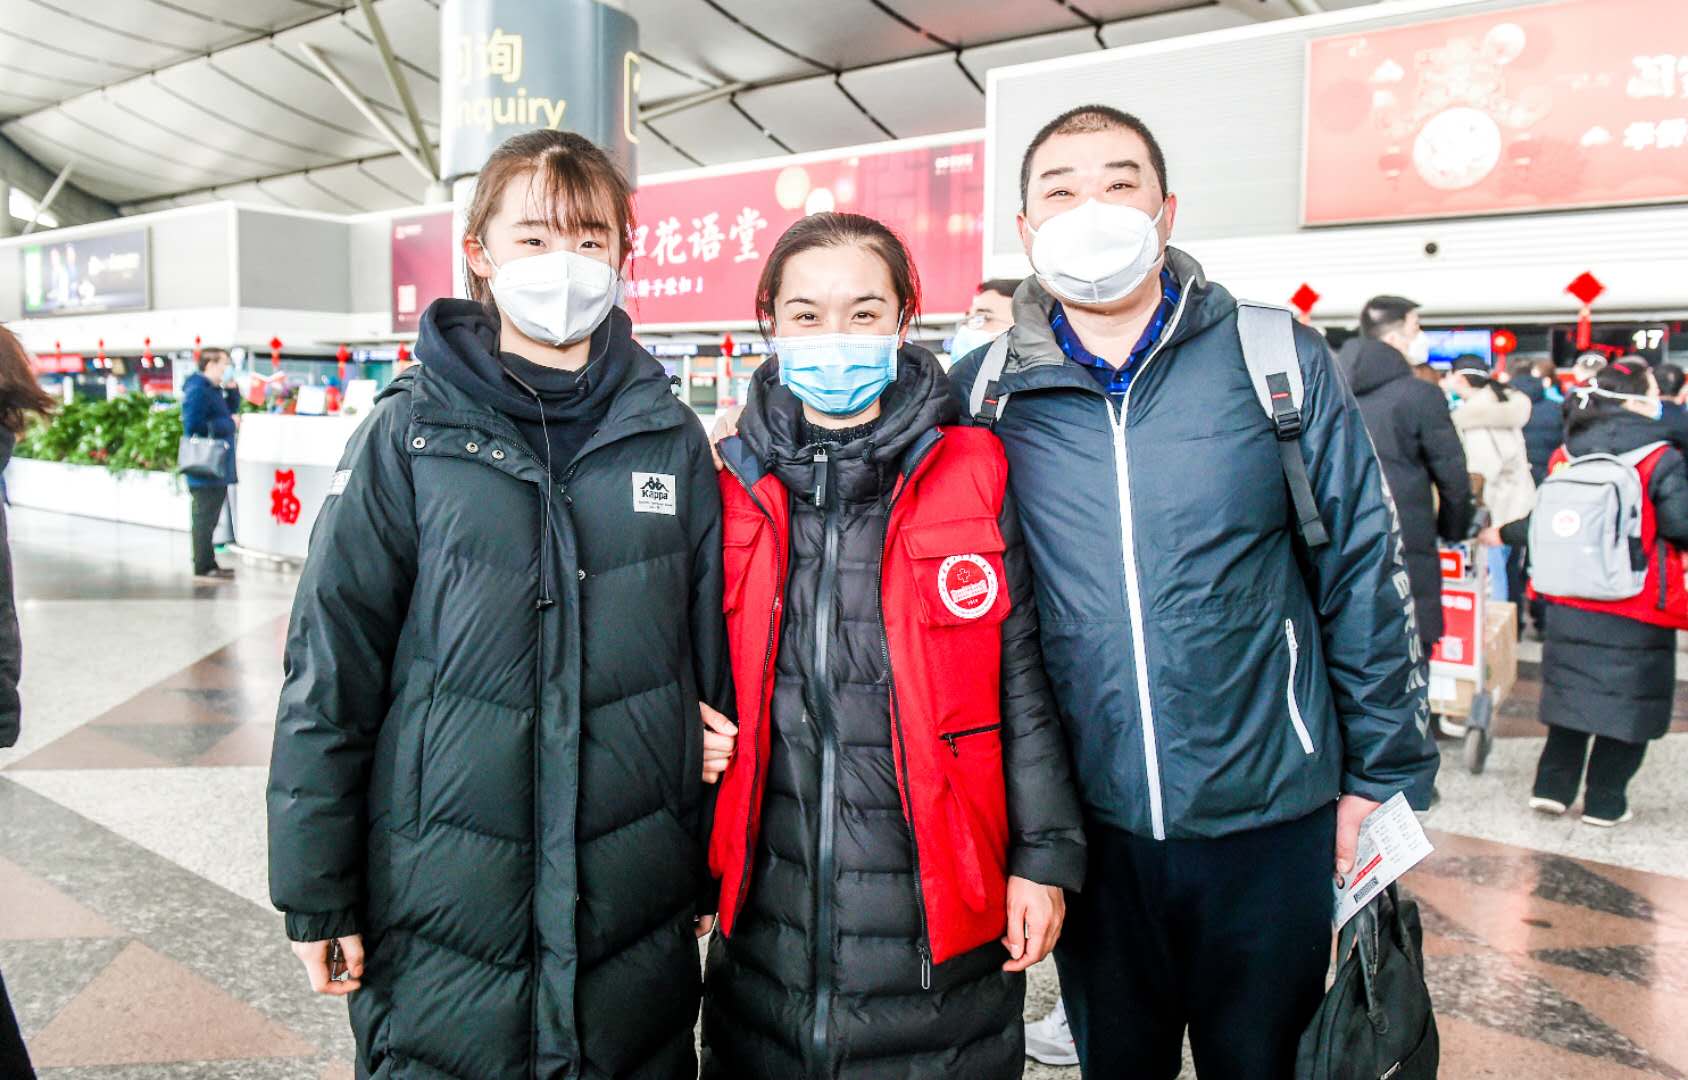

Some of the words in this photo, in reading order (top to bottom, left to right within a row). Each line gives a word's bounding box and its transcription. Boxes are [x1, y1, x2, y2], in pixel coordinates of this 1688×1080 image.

[454, 88, 567, 135] nquiry
[1632, 329, 1665, 350] 17
[641, 489, 668, 501] Kappa
[1381, 474, 1428, 694] NVERSE
